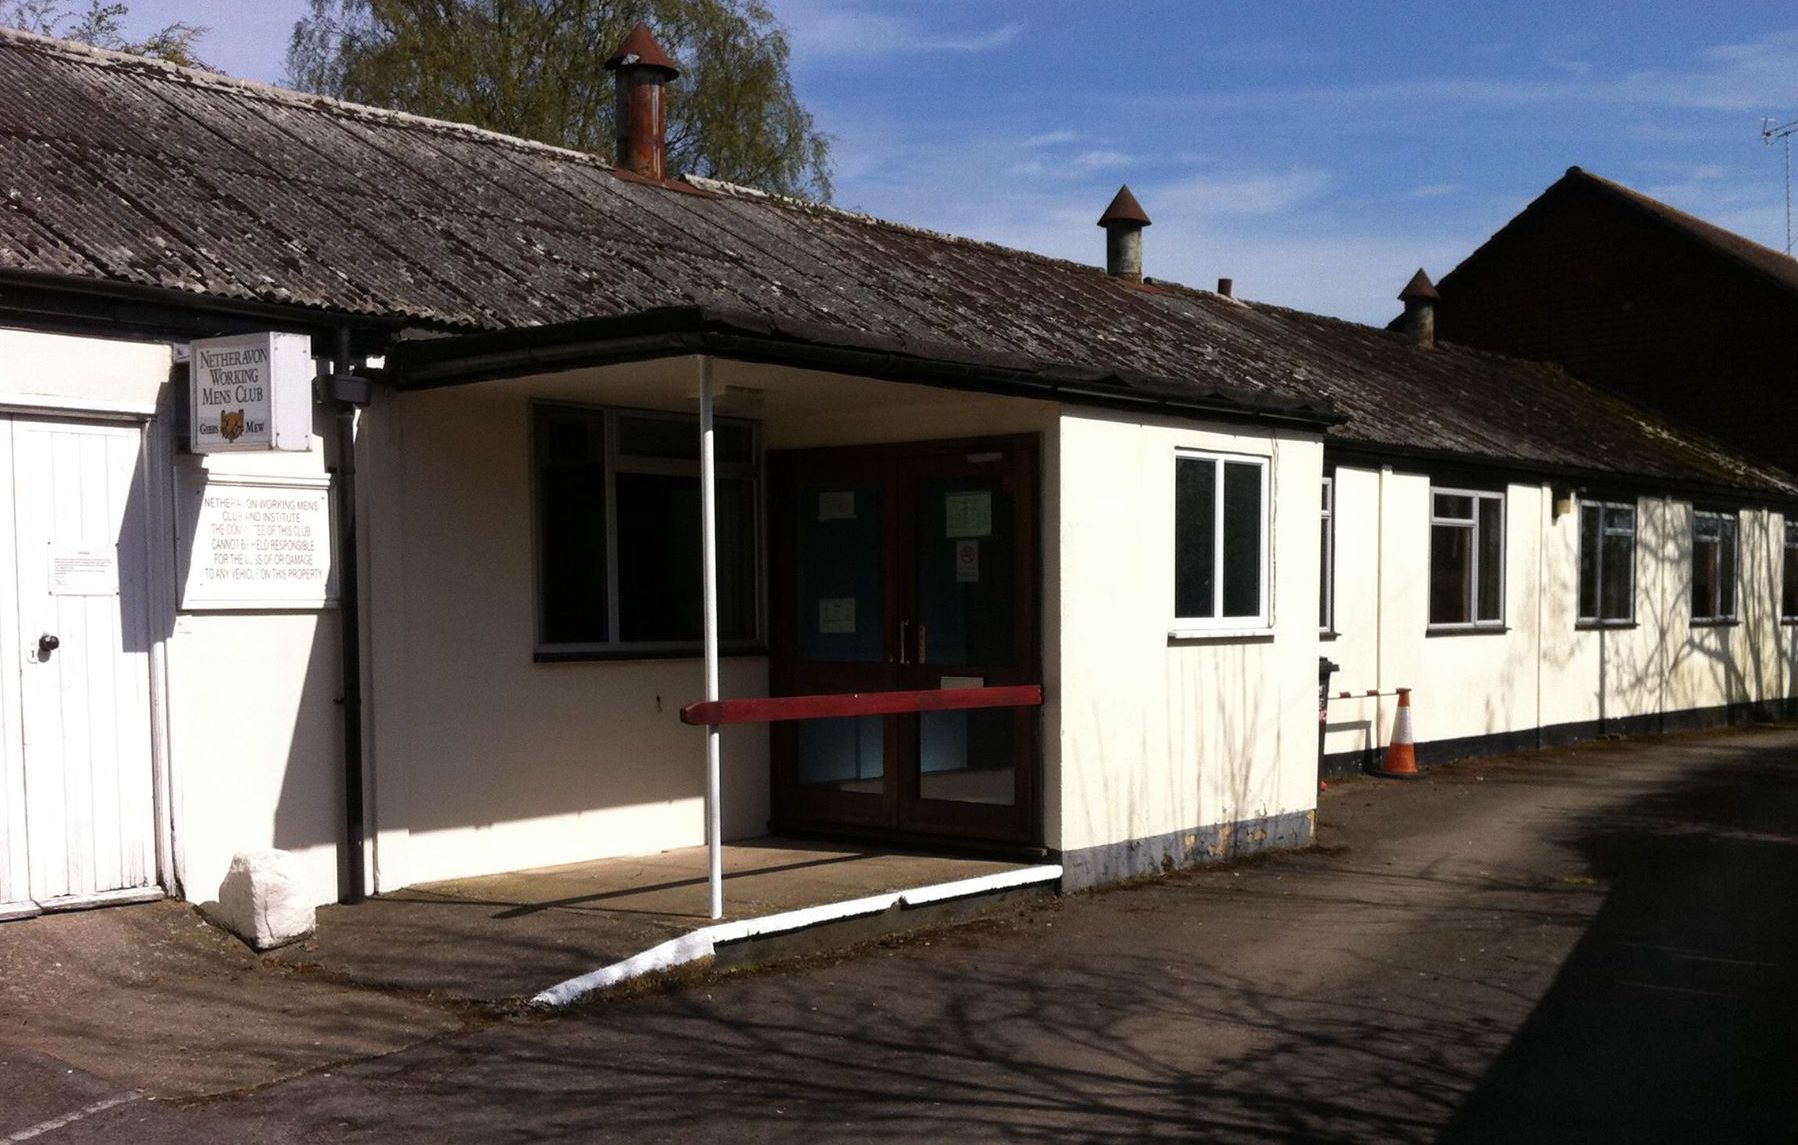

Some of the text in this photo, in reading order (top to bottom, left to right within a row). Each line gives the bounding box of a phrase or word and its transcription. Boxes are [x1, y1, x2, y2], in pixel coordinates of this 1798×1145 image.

[200, 348, 268, 369] NETHERAVON
[210, 367, 259, 386] WORKING
[235, 384, 264, 403] CLUB
[259, 498, 295, 511] WORKING
[297, 500, 319, 512] MENS
[263, 512, 301, 523] INSTITUTE
[211, 523, 225, 535] THE
[211, 538, 239, 550] CANNOT
[214, 553, 229, 565] FOR
[230, 553, 243, 565] THE
[286, 554, 313, 566] DAMAGE
[205, 567, 214, 580] TO
[216, 568, 229, 579] ANY
[260, 568, 271, 580] ON
